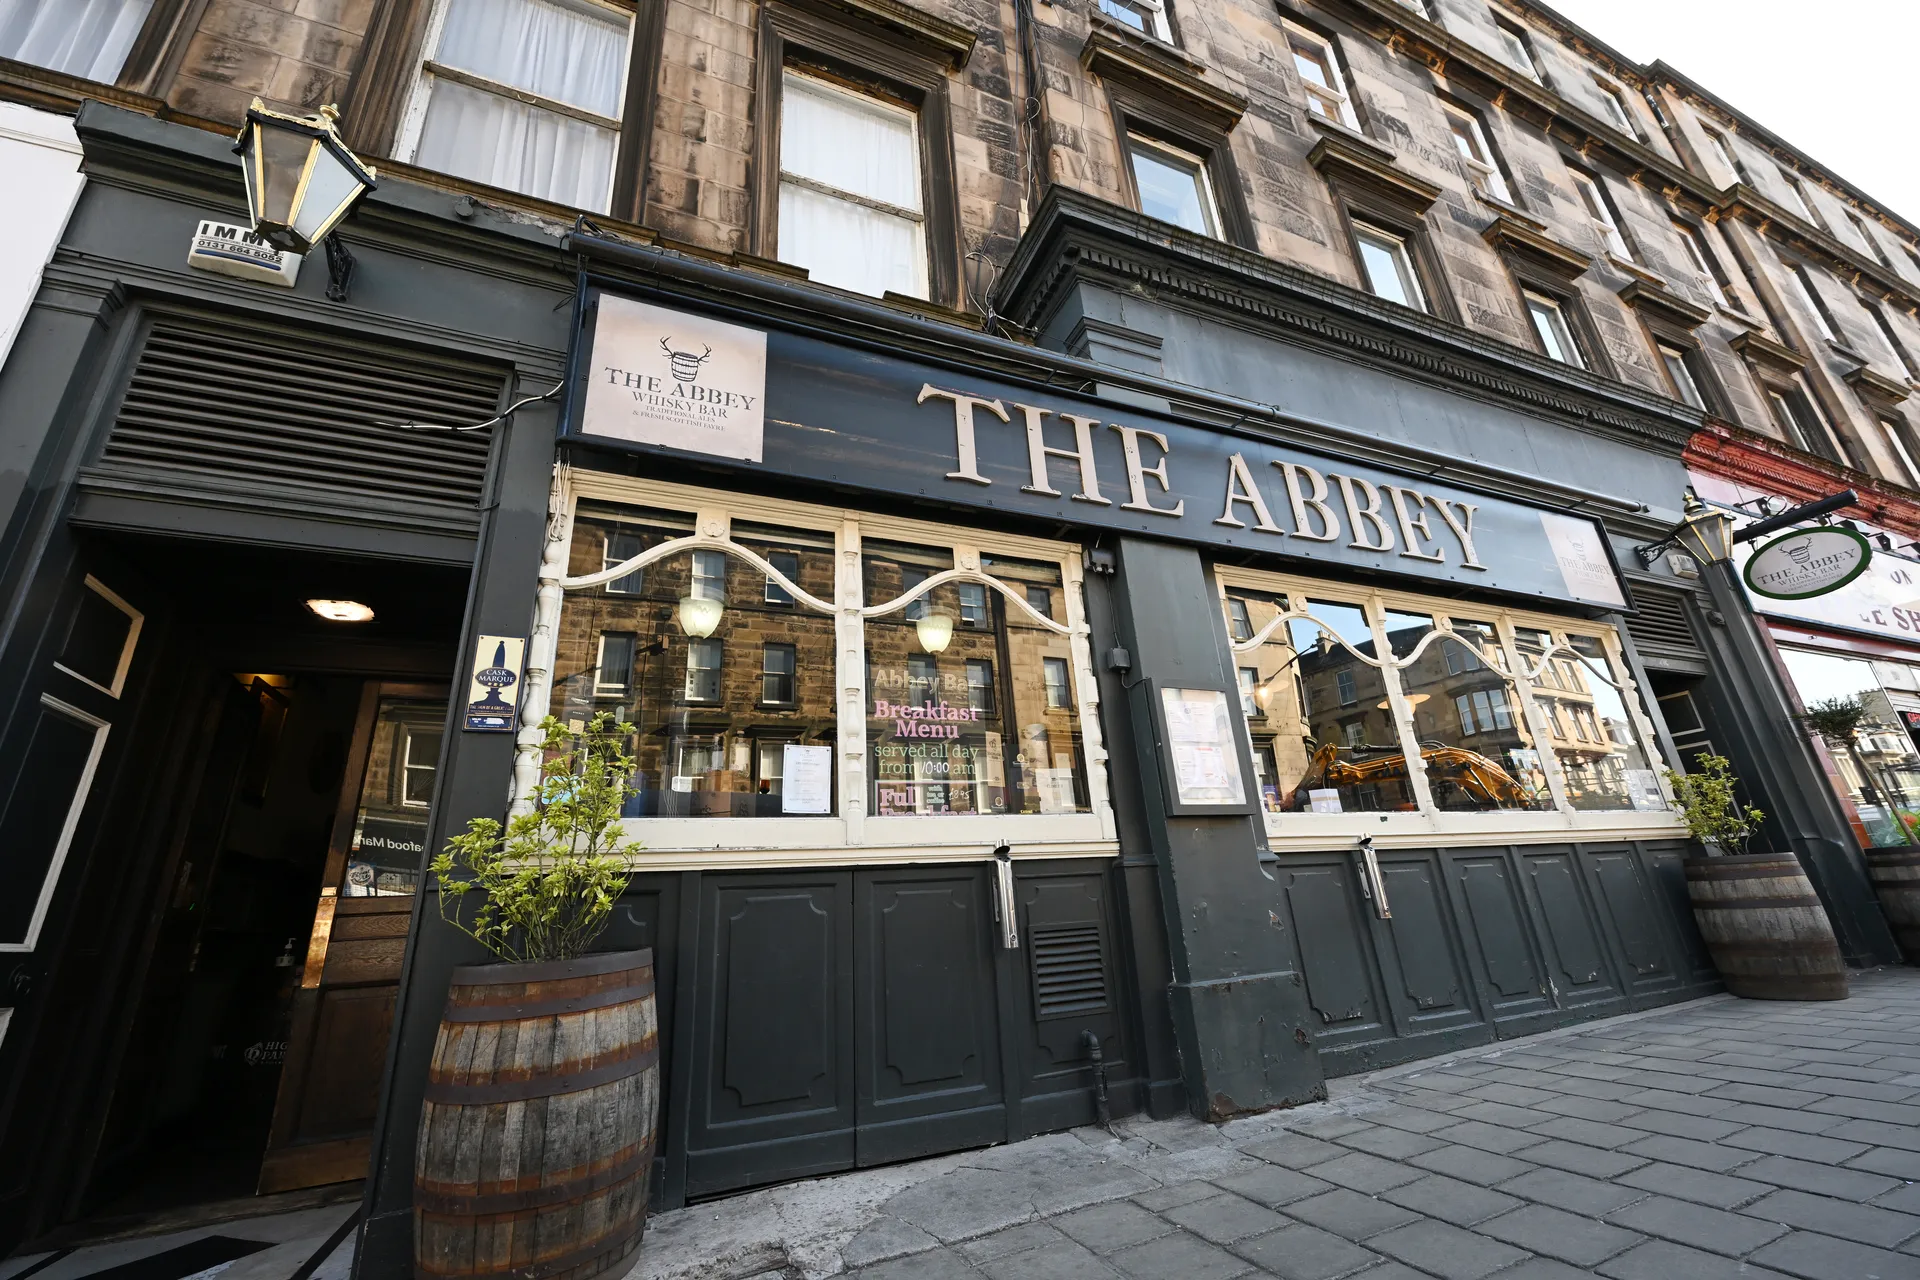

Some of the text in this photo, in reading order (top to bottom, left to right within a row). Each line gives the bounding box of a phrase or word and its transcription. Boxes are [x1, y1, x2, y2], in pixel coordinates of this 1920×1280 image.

[201, 223, 264, 246] IMM
[198, 240, 225, 250] 0131
[229, 244, 251, 255] 664
[253, 251, 283, 262] 5052
[605, 366, 757, 411] THE ABBEY
[632, 391, 728, 418] WHISKY BAR
[645, 404, 716, 423] TRADITIONAL ALES
[640, 411, 665, 421] FRESH
[665, 416, 702, 427] SCOTTISH
[703, 423, 727, 432] FAYRE
[917, 382, 1489, 571] THE ABBEY
[1560, 556, 1611, 576] THE ABBEY
[1757, 548, 1856, 585] THE ABBEY
[1778, 564, 1842, 586] WHISKY BAR
[478, 675, 514, 683] MARQUE
[874, 669, 977, 695] Abbey Bar
[874, 700, 979, 722] Breakfast
[895, 720, 960, 739] Menu
[874, 744, 927, 758] served
[930, 743, 949, 758] all
[952, 743, 980, 761] day
[879, 760, 916, 775] from
[953, 763, 977, 775] am
[880, 786, 919, 807] Full
